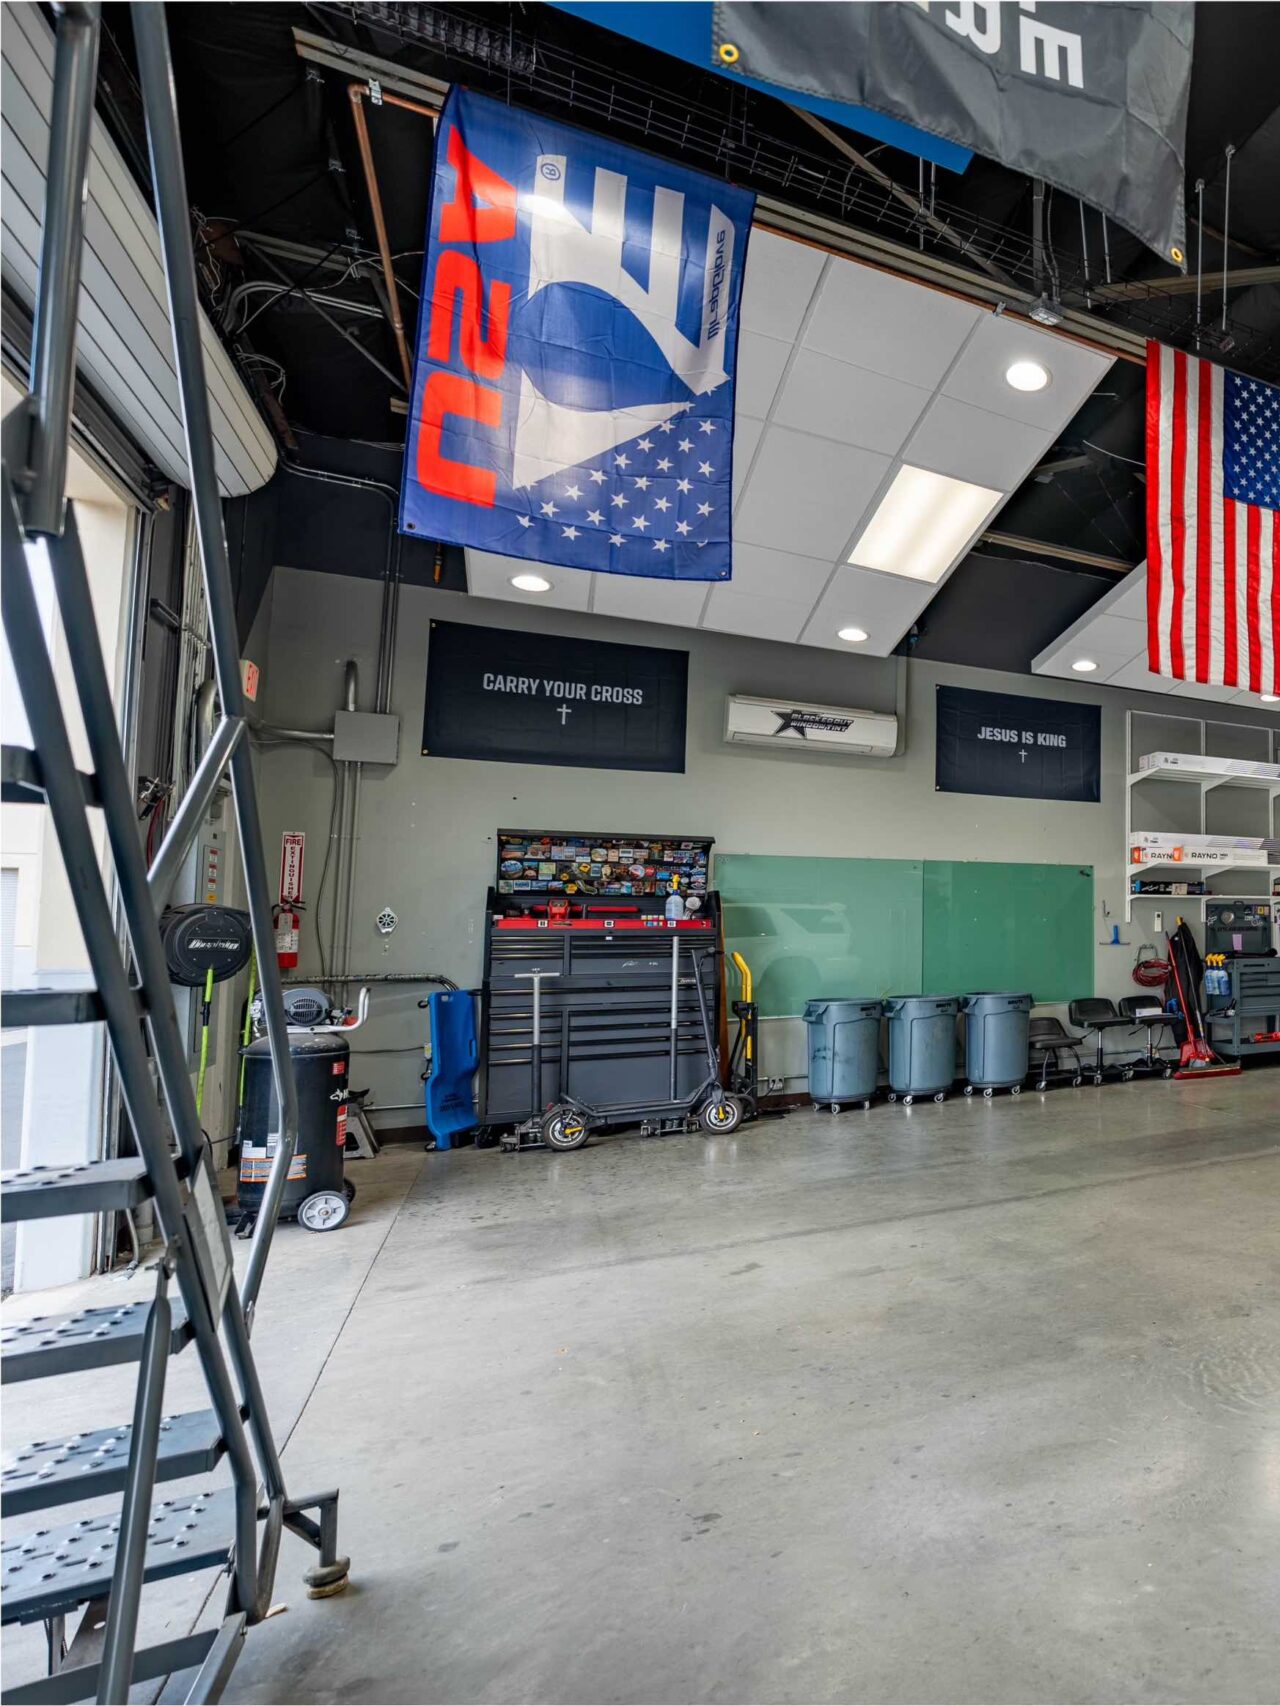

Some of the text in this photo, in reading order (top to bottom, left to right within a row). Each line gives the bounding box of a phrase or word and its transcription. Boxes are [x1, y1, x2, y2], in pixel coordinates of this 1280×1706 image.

[482, 672, 644, 705] CARRY YOUR CROSS
[977, 726, 1067, 748] JESUS IS KING
[285, 838, 302, 846] FIRE
[1150, 852, 1174, 860] RAYN
